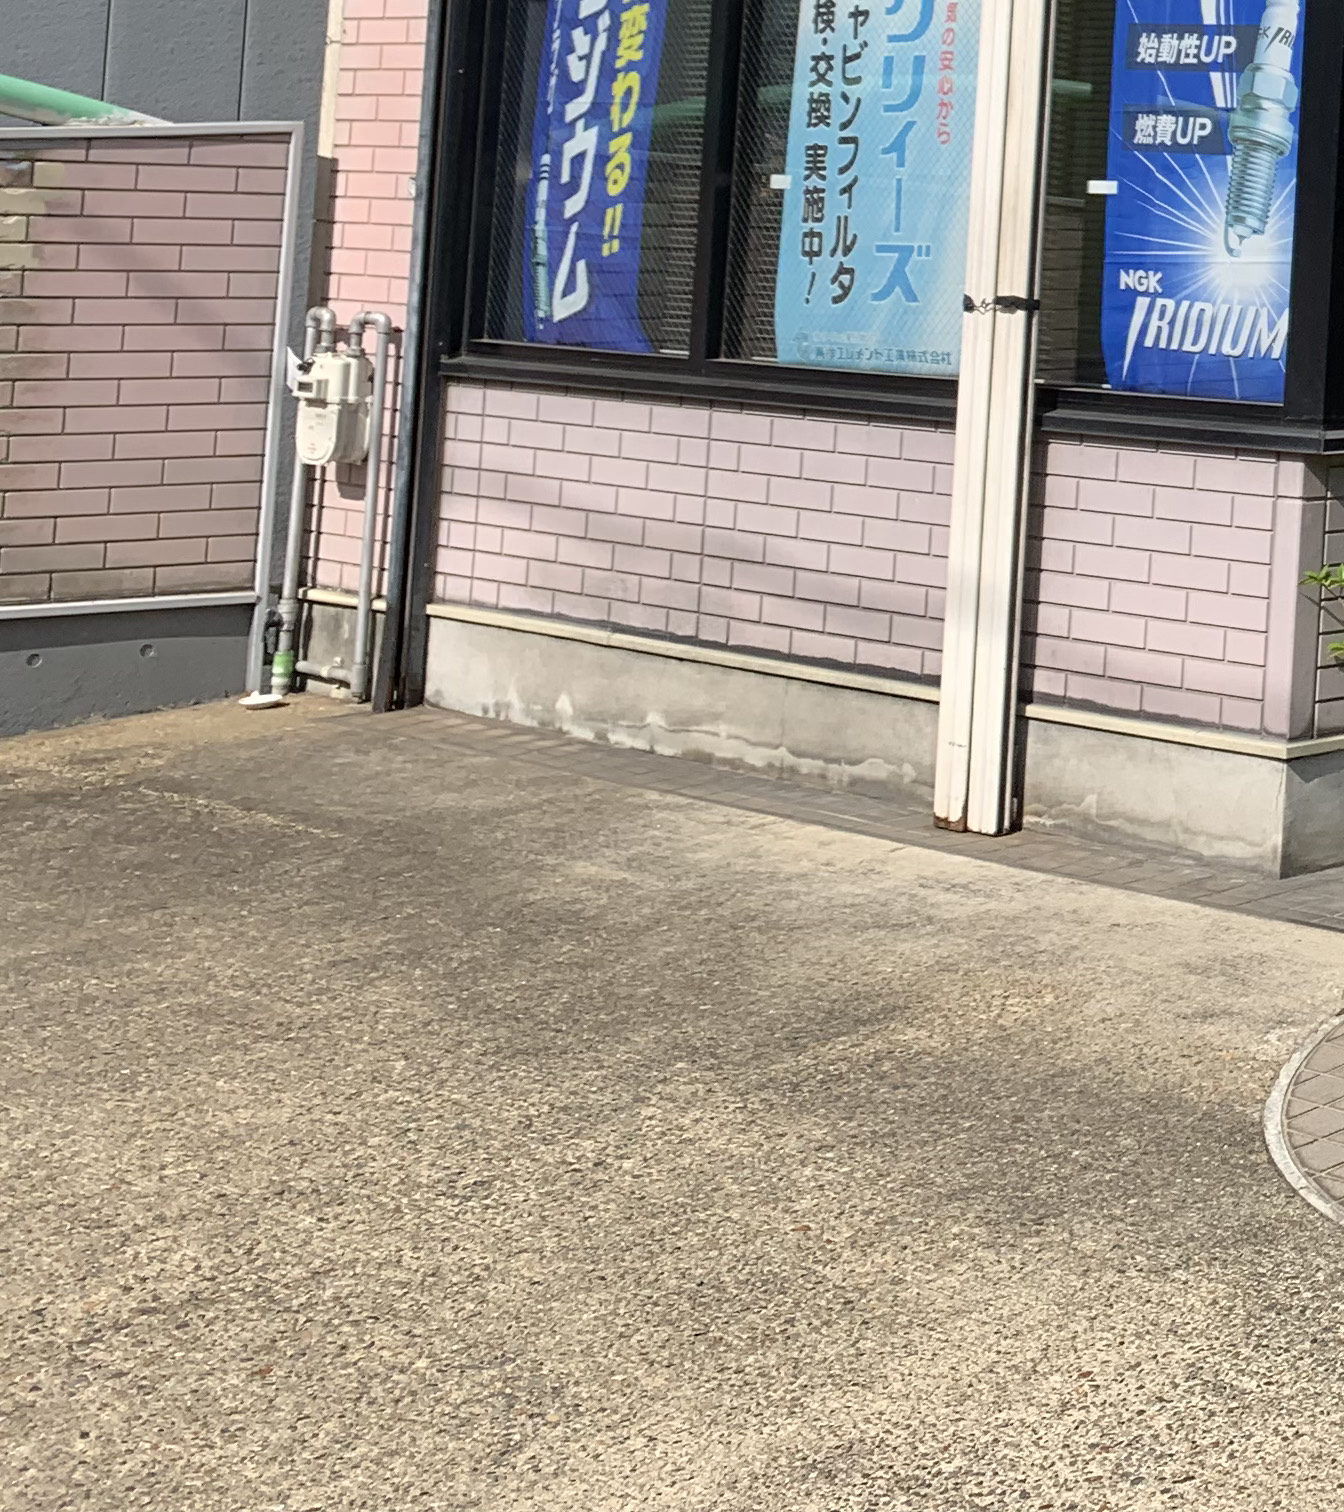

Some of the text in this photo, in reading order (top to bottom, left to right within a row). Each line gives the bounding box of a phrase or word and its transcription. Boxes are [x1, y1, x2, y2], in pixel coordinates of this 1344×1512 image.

[1136, 33, 1237, 65] 始動性UP
[1133, 114, 1213, 147] 燃費UP
[1120, 269, 1163, 294] NGK
[1122, 296, 1289, 382] IRIDIUM
